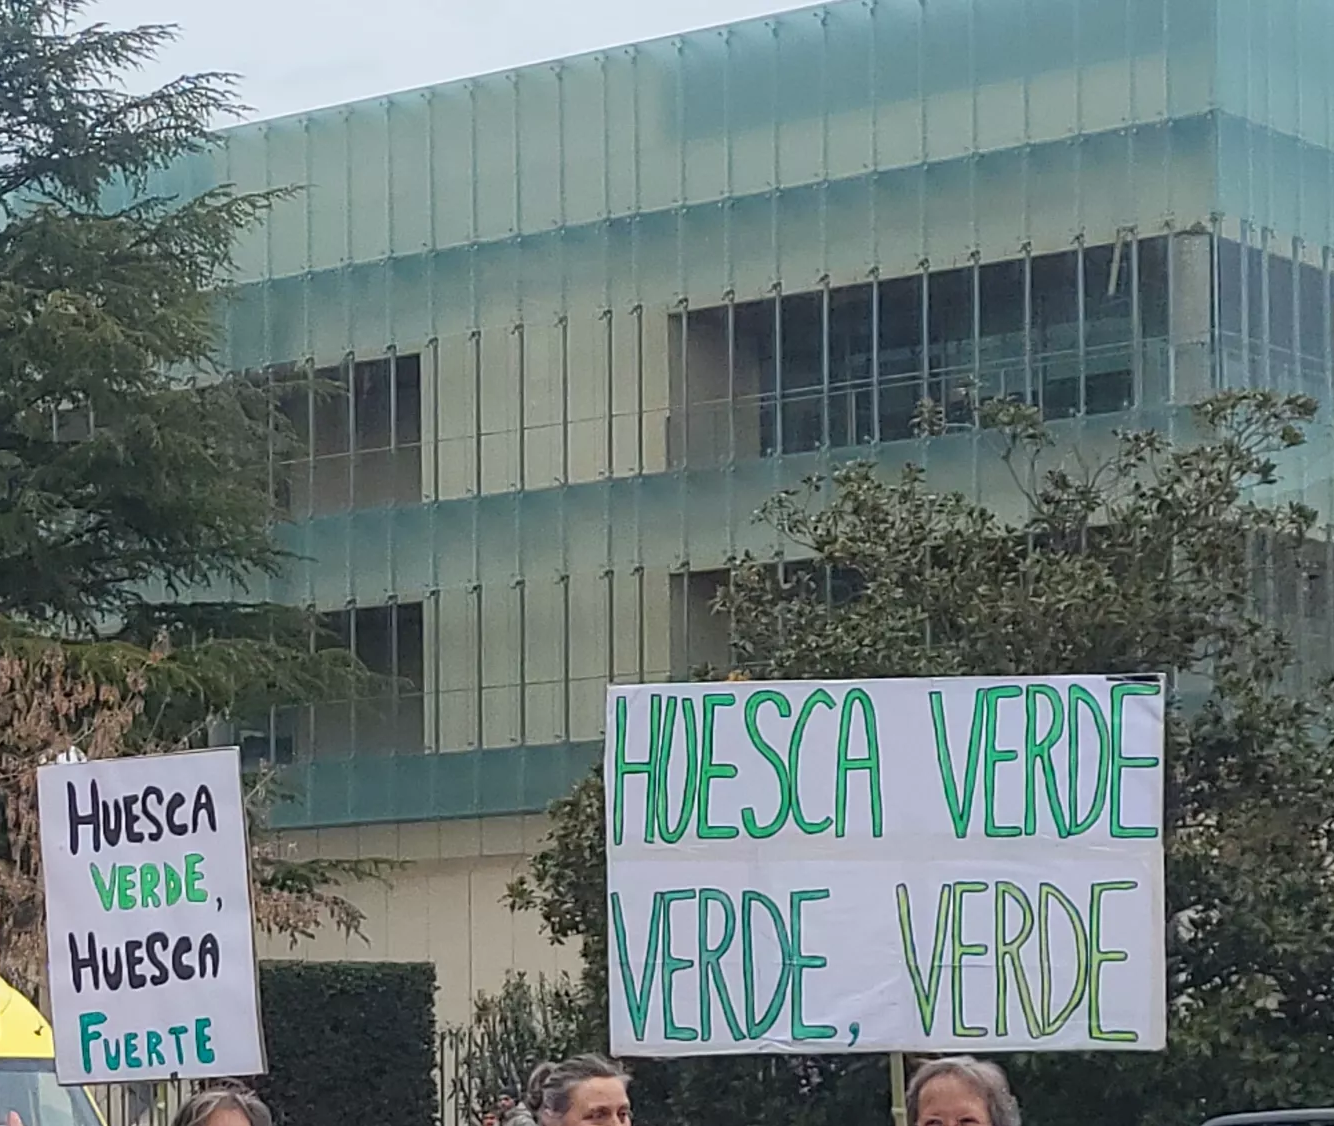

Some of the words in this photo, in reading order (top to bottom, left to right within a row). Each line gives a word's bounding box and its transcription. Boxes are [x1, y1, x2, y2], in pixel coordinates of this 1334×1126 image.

[613, 688, 884, 845] HUESCA
[929, 684, 1162, 839] VERDE
[67, 780, 218, 856] HUESCA
[89, 853, 224, 912] VERDE,
[68, 931, 220, 994] HUESCA
[610, 887, 862, 1048] VERDE,
[895, 881, 1139, 1043] VERDE
[78, 1011, 216, 1075] FUERTE
